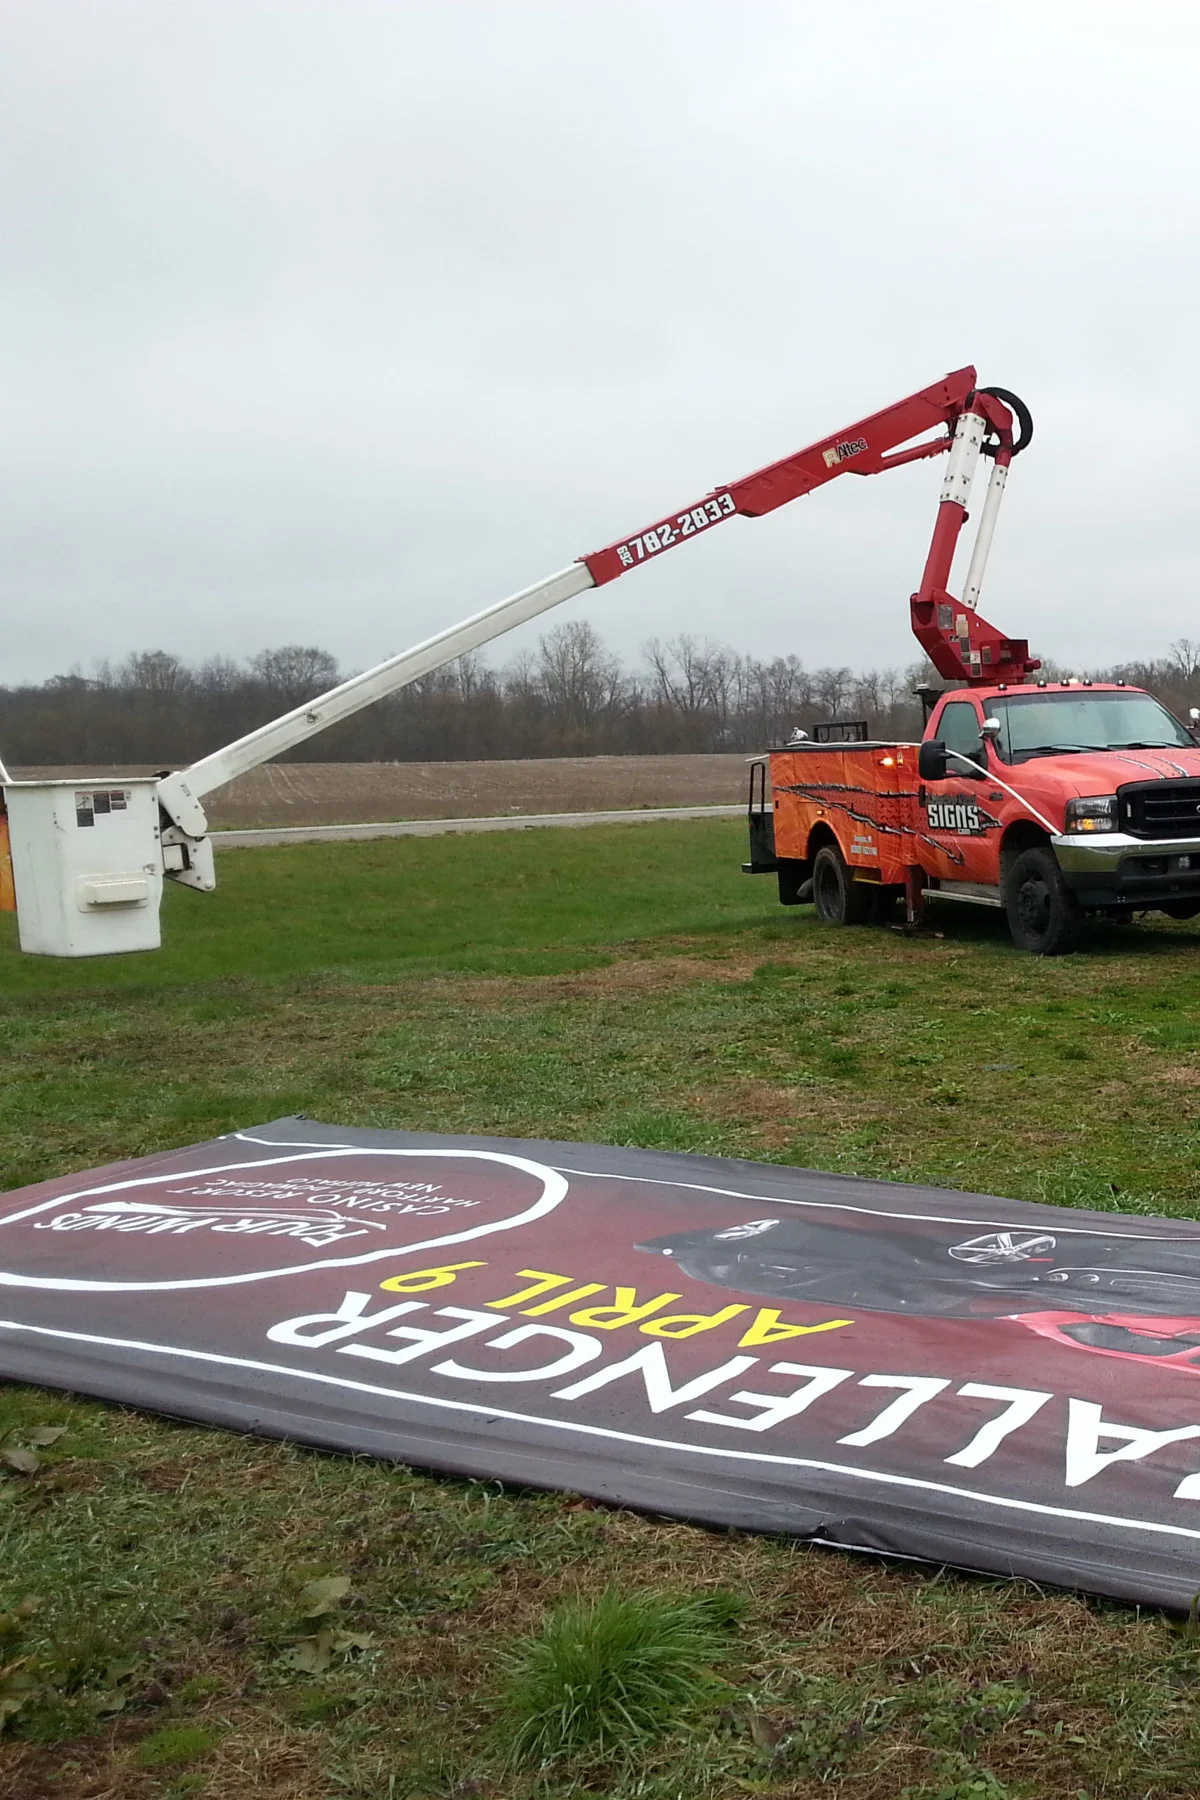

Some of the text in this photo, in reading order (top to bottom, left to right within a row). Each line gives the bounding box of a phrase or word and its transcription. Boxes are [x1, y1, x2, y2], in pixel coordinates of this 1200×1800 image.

[837, 438, 868, 461] Altec
[628, 493, 736, 560] 782-2833
[927, 803, 980, 830] SIGNS
[166, 1187, 451, 1216] CASINO RESORT
[352, 1187, 481, 1208] HARTFORD
[382, 1182, 443, 1193] NEW
[33, 1212, 370, 1248] FOUR WINDS
[379, 1260, 856, 1348] APRIL 9
